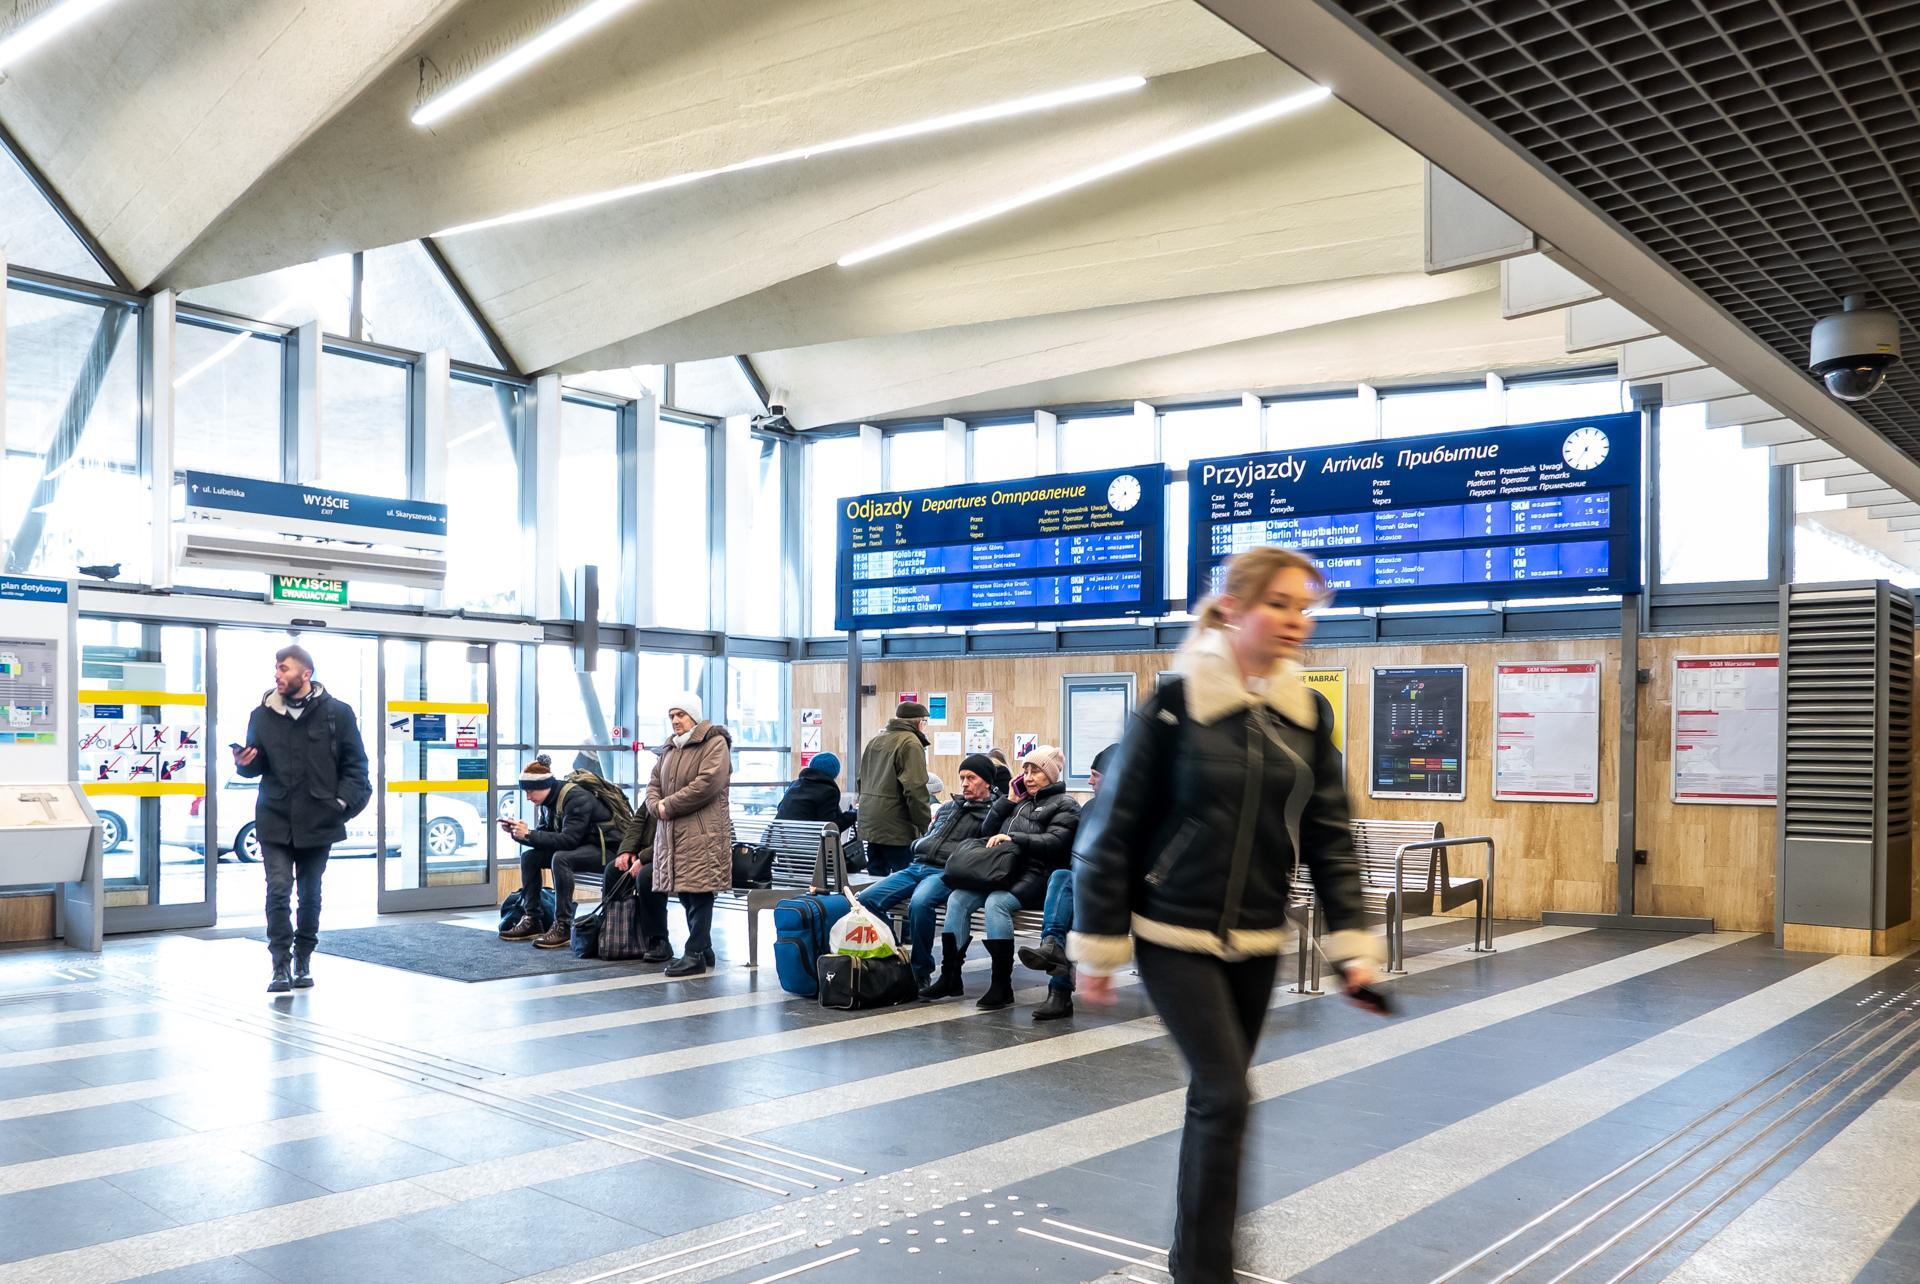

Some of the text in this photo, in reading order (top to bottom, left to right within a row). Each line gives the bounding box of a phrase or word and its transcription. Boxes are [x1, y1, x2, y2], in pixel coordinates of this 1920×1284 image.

[1397, 444, 1499, 469] Прибытие
[1203, 452, 1384, 488] Przyjazdy Arrivals
[1475, 463, 1563, 477] Peron Przewoźnik Uwagi
[1467, 471, 1570, 488] Platform Operator Remarks
[213, 487, 245, 498] Lubelska
[991, 485, 1086, 505] Отправление
[1234, 492, 1253, 500] Pociąg
[1469, 480, 1586, 497] Перрон Перевозчик Примечание
[303, 494, 349, 510] WYJŚCIE
[846, 495, 987, 522] Odjazdy Departures
[1234, 500, 1249, 508] Train
[1271, 497, 1286, 505] From
[386, 509, 436, 522] ul. Skaryszewska
[1063, 515, 1084, 523] Operator
[1267, 519, 1299, 529] Otwock
[1486, 504, 1491, 513] 6
[1511, 501, 1530, 511] SKM
[1267, 531, 1291, 540] Berlin
[1294, 524, 1359, 539] Hauptbahnhof
[1485, 515, 1491, 524] 4
[1515, 512, 1525, 521] IC
[1327, 535, 1361, 546] Główna
[1485, 526, 1491, 535] 4
[1515, 524, 1525, 532] IC
[893, 551, 926, 559] Kołobrzeg
[1074, 537, 1081, 545] IC
[894, 559, 925, 567] Pruszków
[1071, 546, 1084, 554] SKM
[893, 567, 910, 576] Łódź
[911, 566, 945, 576] Fabryczna
[1055, 557, 1059, 565] 1
[1074, 556, 1081, 564] IC
[1327, 558, 1361, 568] Główna
[1485, 550, 1491, 558] 4
[1515, 548, 1525, 556] IC
[1485, 561, 1491, 569] 5
[1513, 559, 1526, 567] KM
[1485, 572, 1491, 580] 4
[1515, 570, 1525, 578] IC
[1, 582, 62, 594] plan dotykowy
[893, 587, 916, 595] Otwock
[1071, 576, 1084, 584] SKM
[282, 589, 339, 602] EWAKUACYJNE
[893, 604, 915, 612] Łowicz
[917, 603, 942, 611] Główny
[1309, 673, 1339, 682] NABRAĆ
